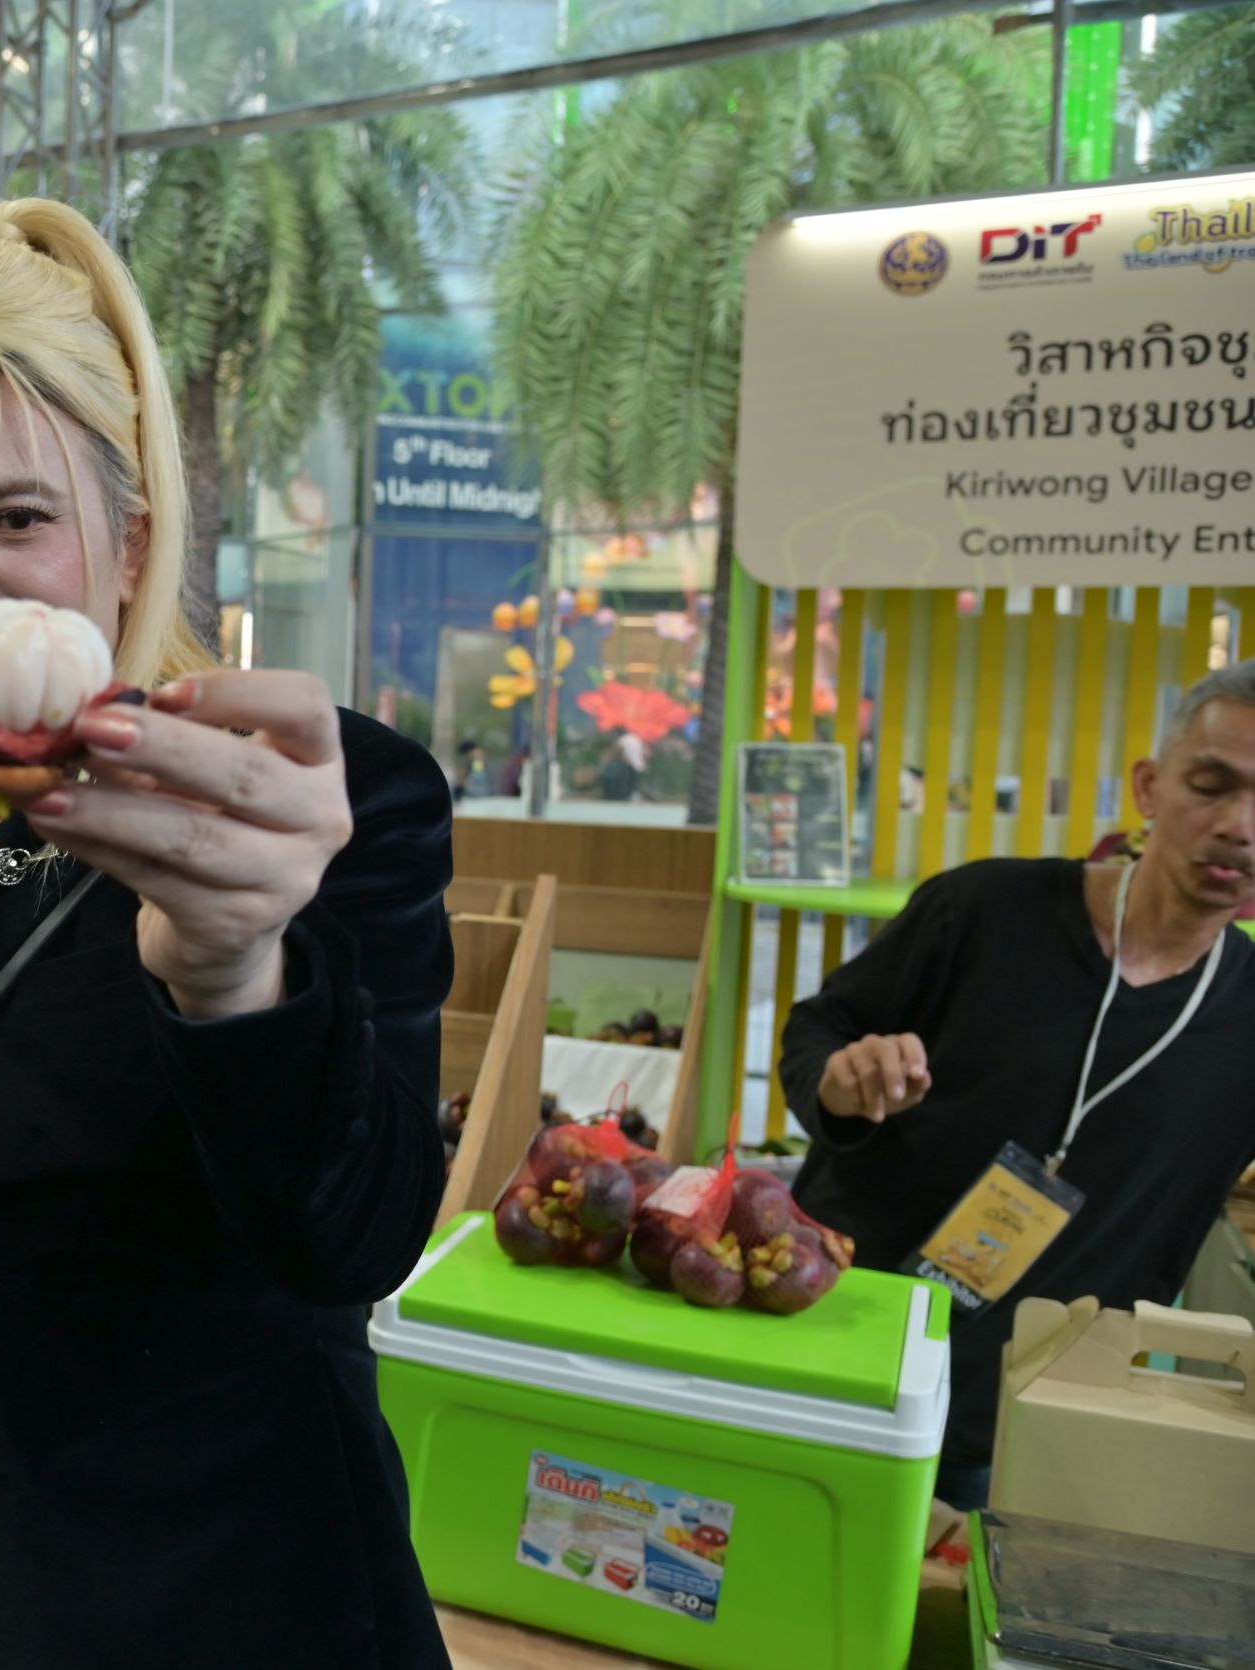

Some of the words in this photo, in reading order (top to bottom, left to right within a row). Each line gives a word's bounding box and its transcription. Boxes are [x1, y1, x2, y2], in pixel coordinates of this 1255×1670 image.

[1007, 321, 1255, 379] วิสาหกิจชุ
[881, 382, 1255, 449] ท่องเที่ยวชุมชน
[428, 438, 491, 470] Floor
[386, 475, 446, 509] Until
[945, 470, 1109, 503] Kiriwong
[1122, 466, 1253, 499] Village
[959, 526, 1182, 562] Community
[673, 1590, 701, 1610] 20
